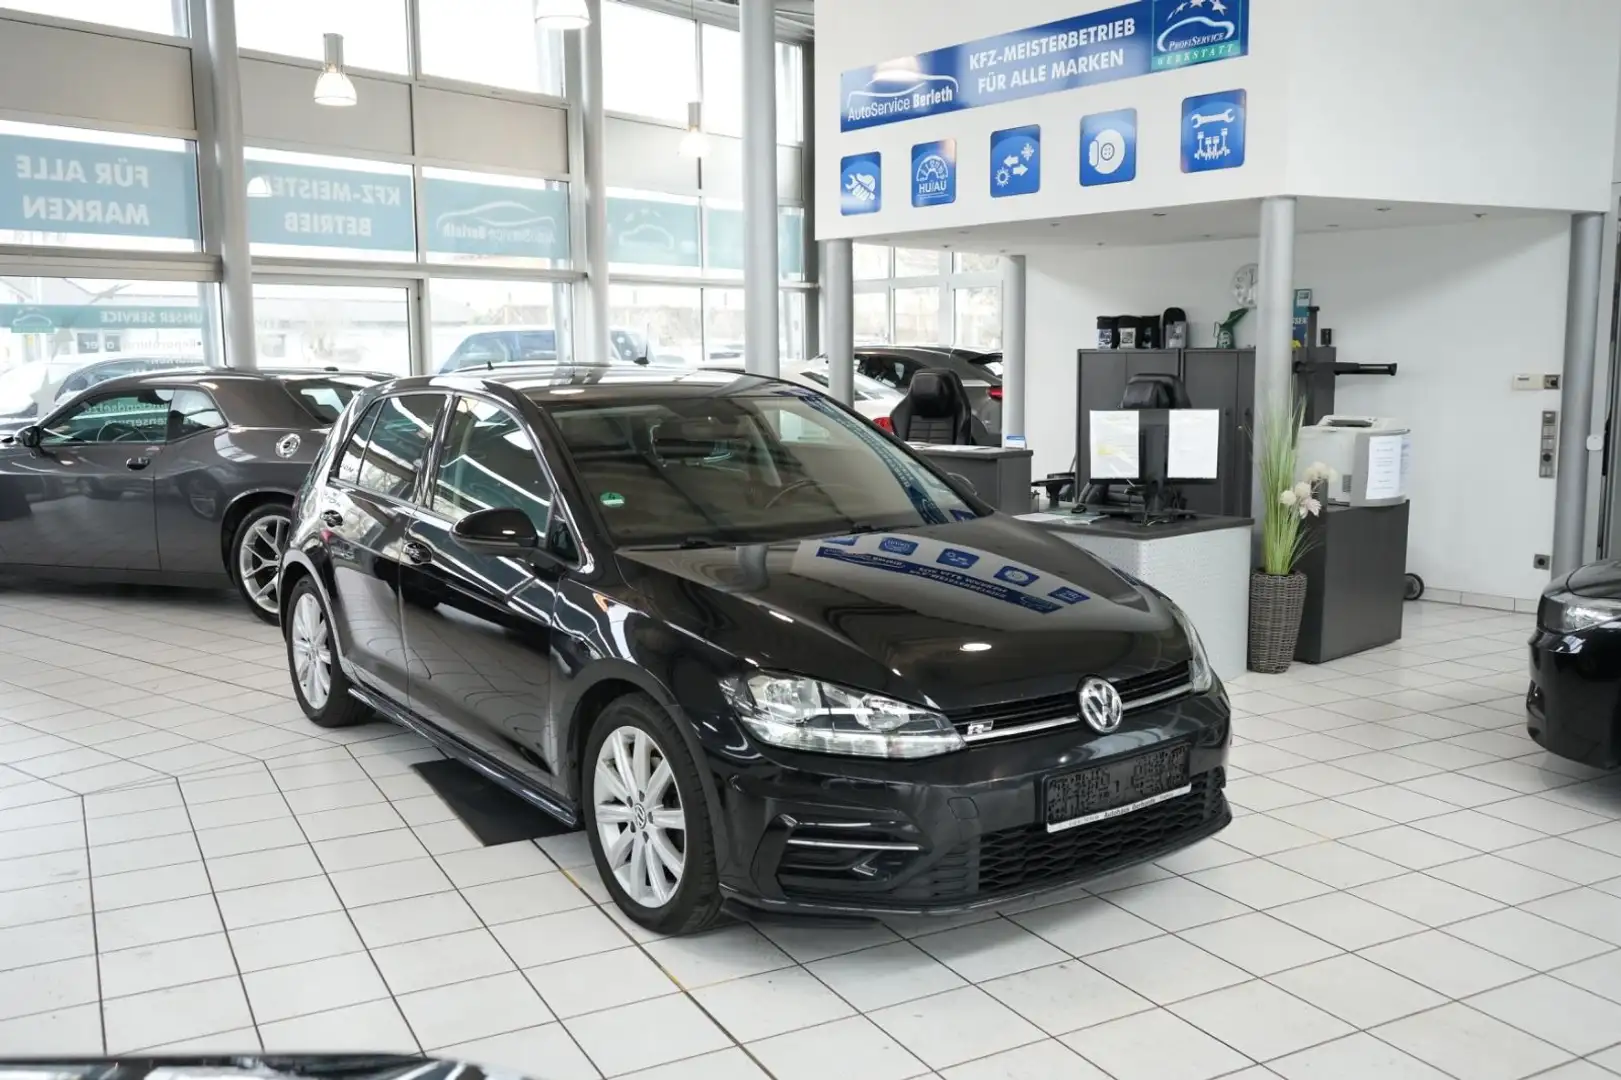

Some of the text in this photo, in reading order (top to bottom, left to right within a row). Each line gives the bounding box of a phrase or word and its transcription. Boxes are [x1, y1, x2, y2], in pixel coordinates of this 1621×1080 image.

[969, 17, 1136, 71] KFZ-MEISTERBETRIEB
[978, 48, 1124, 95] FÜR ALLE MARKEN
[847, 86, 953, 122] AutoService Berleth
